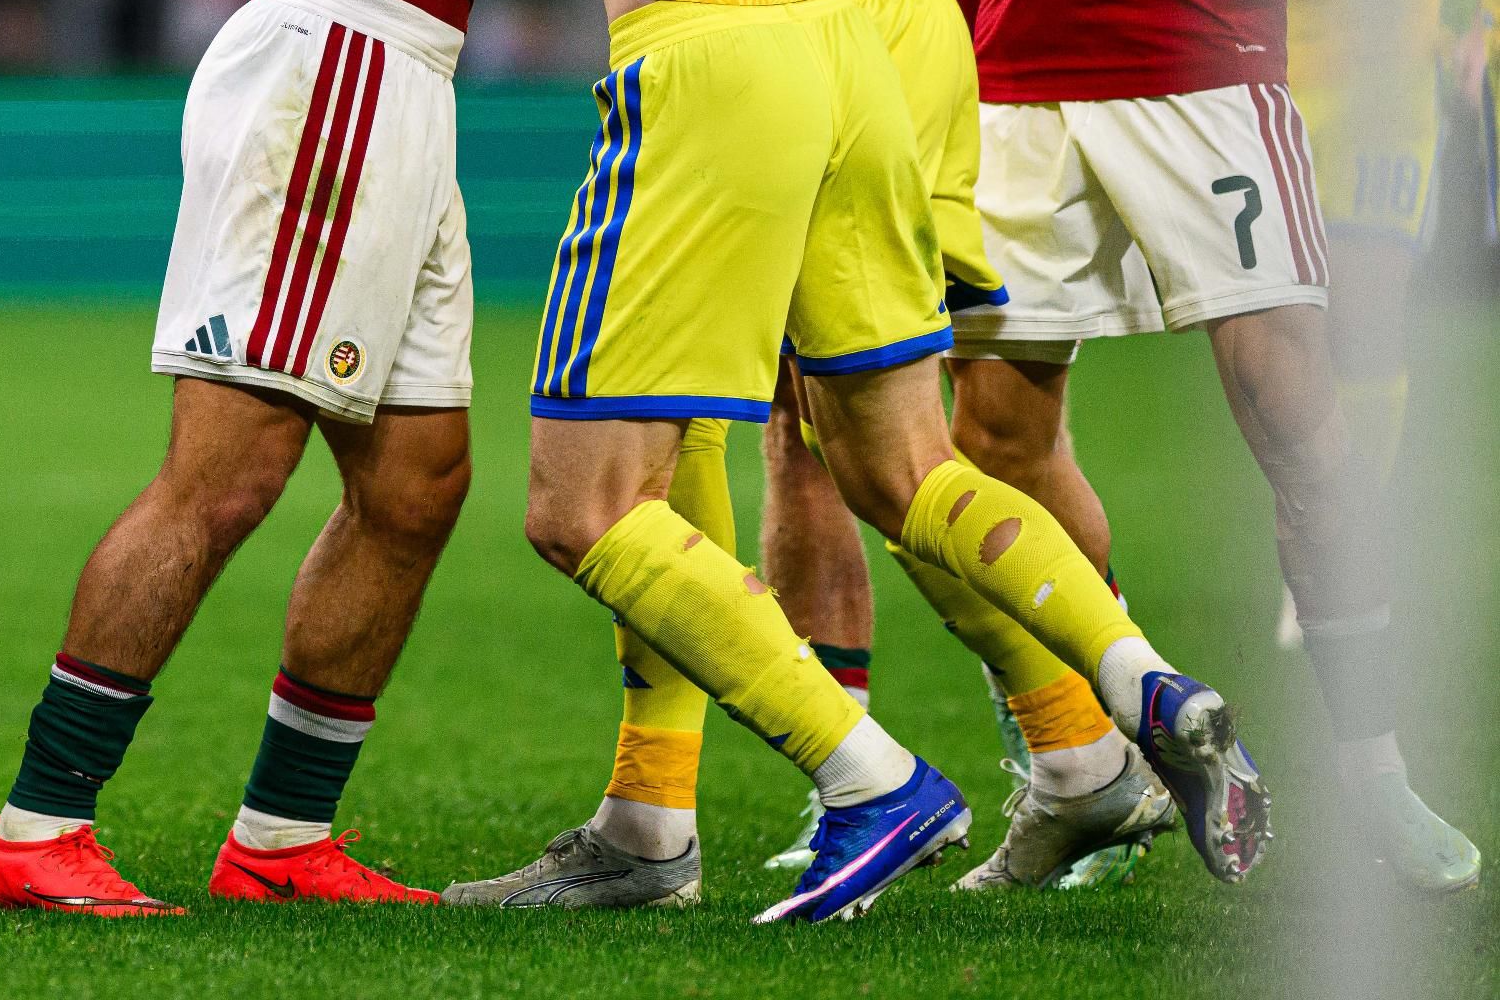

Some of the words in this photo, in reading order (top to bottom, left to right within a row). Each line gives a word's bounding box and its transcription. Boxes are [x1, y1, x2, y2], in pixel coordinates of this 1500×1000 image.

[1211, 174, 1263, 270] 7
[909, 815, 936, 840] AIR
[935, 799, 956, 818] ZOOM
